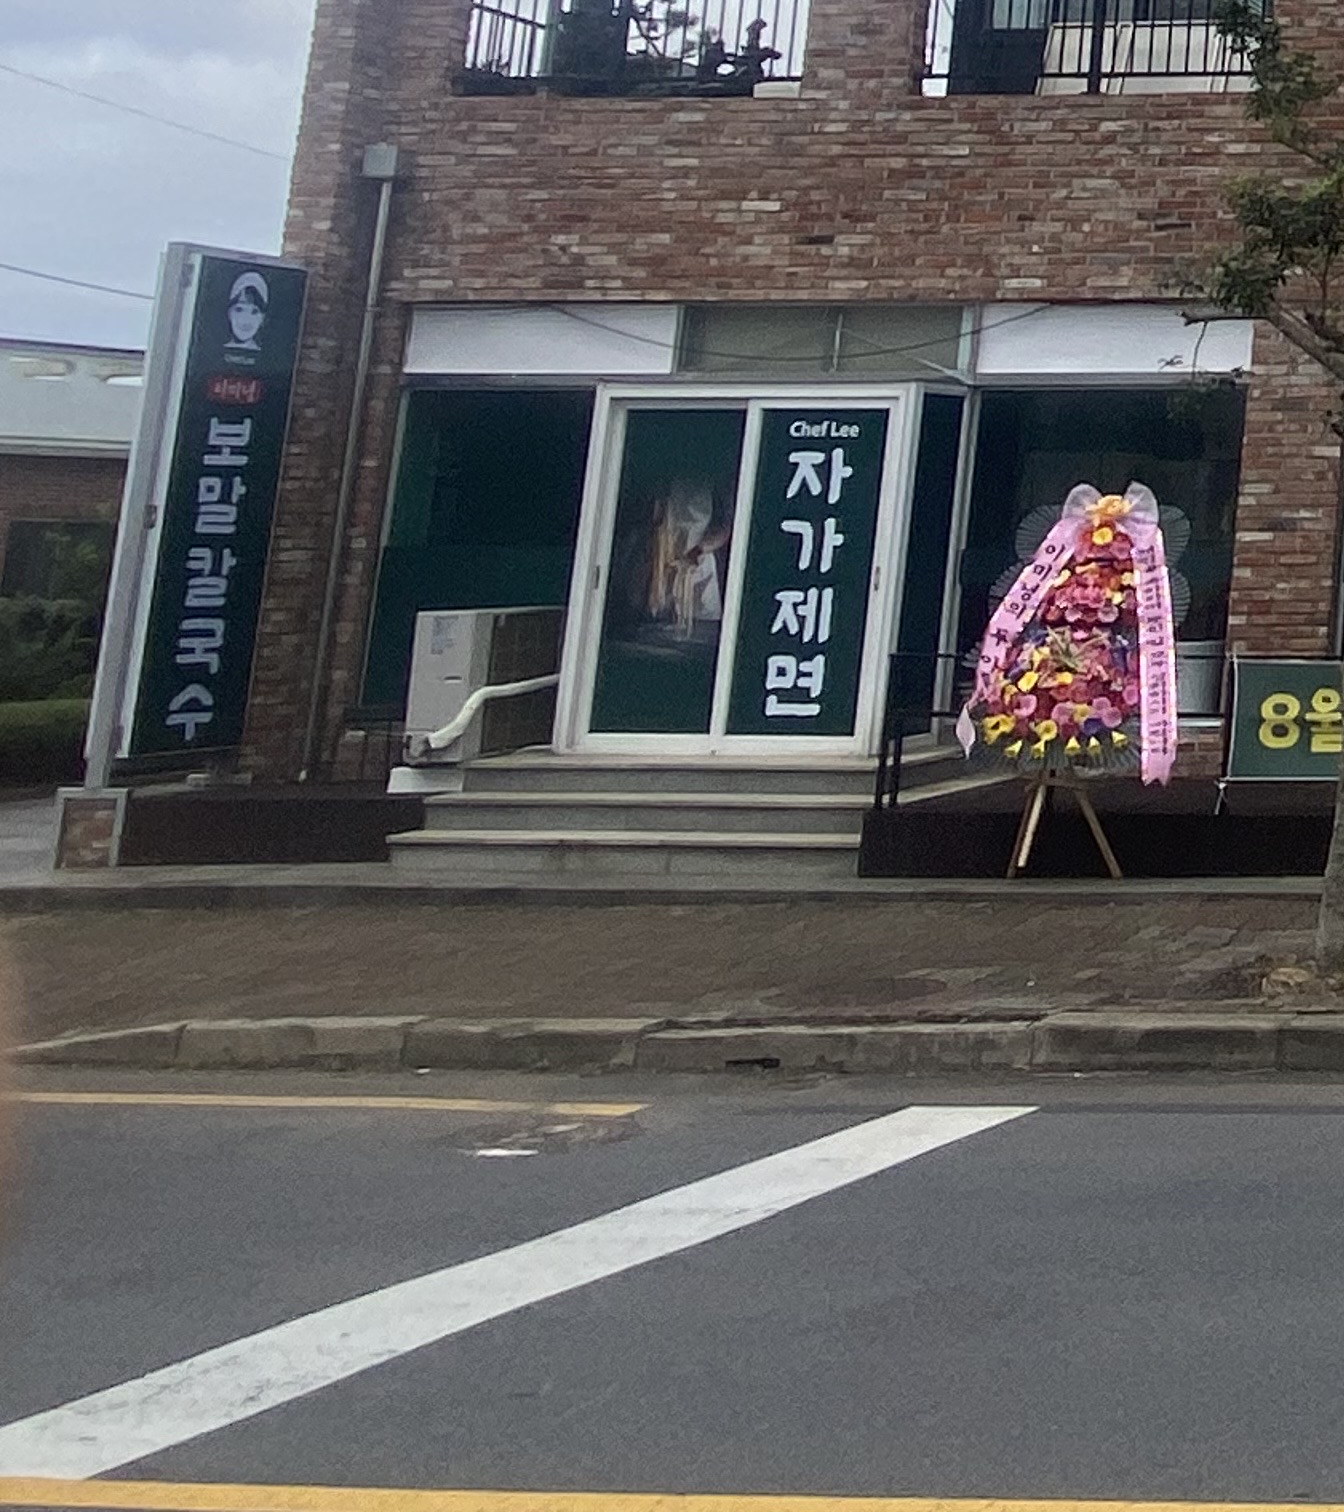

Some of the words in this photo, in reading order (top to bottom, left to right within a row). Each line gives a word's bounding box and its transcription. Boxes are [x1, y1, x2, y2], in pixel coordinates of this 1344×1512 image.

[789, 420, 830, 437] Chef
[830, 421, 859, 437] Lee
[165, 416, 252, 741] 보말칼국수
[765, 447, 853, 717] 자가제면
